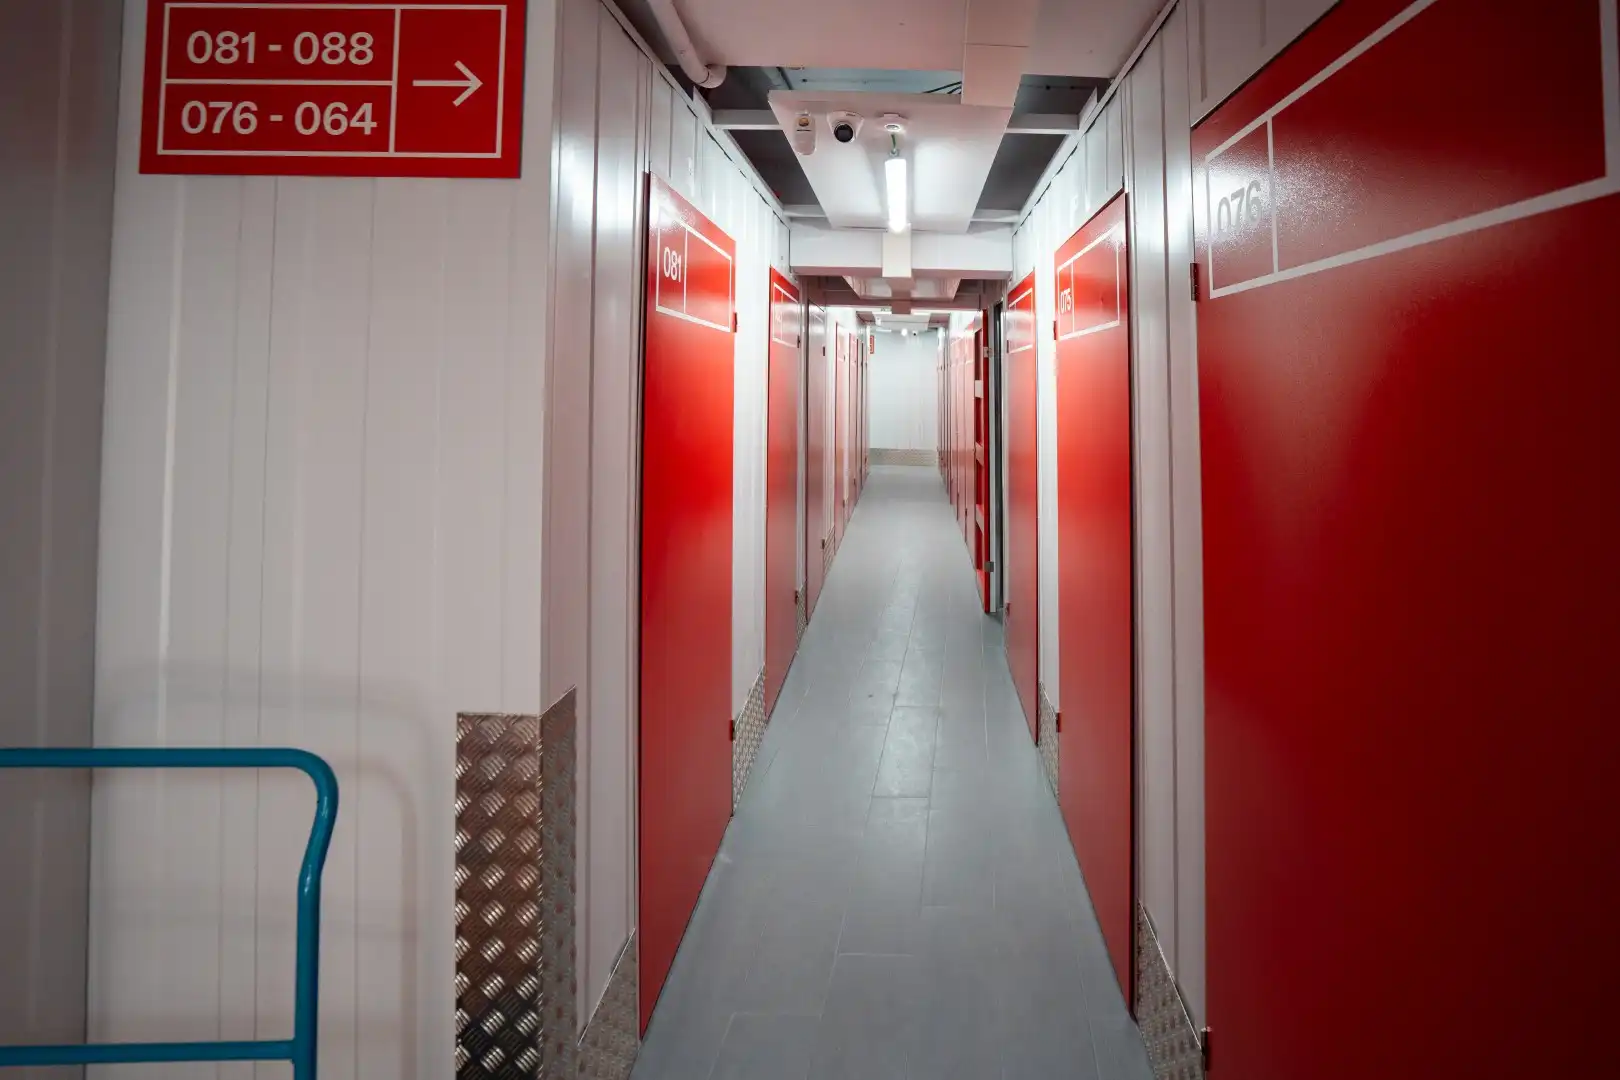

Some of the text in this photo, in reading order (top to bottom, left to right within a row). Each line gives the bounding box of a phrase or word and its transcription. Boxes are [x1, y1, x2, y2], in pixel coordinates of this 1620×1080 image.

[187, 31, 255, 64] 081
[293, 31, 374, 65] 088
[181, 101, 258, 134] 076
[294, 101, 377, 135] 064
[1217, 179, 1262, 239] 076
[663, 246, 682, 282] 081
[1060, 288, 1072, 314] 075
